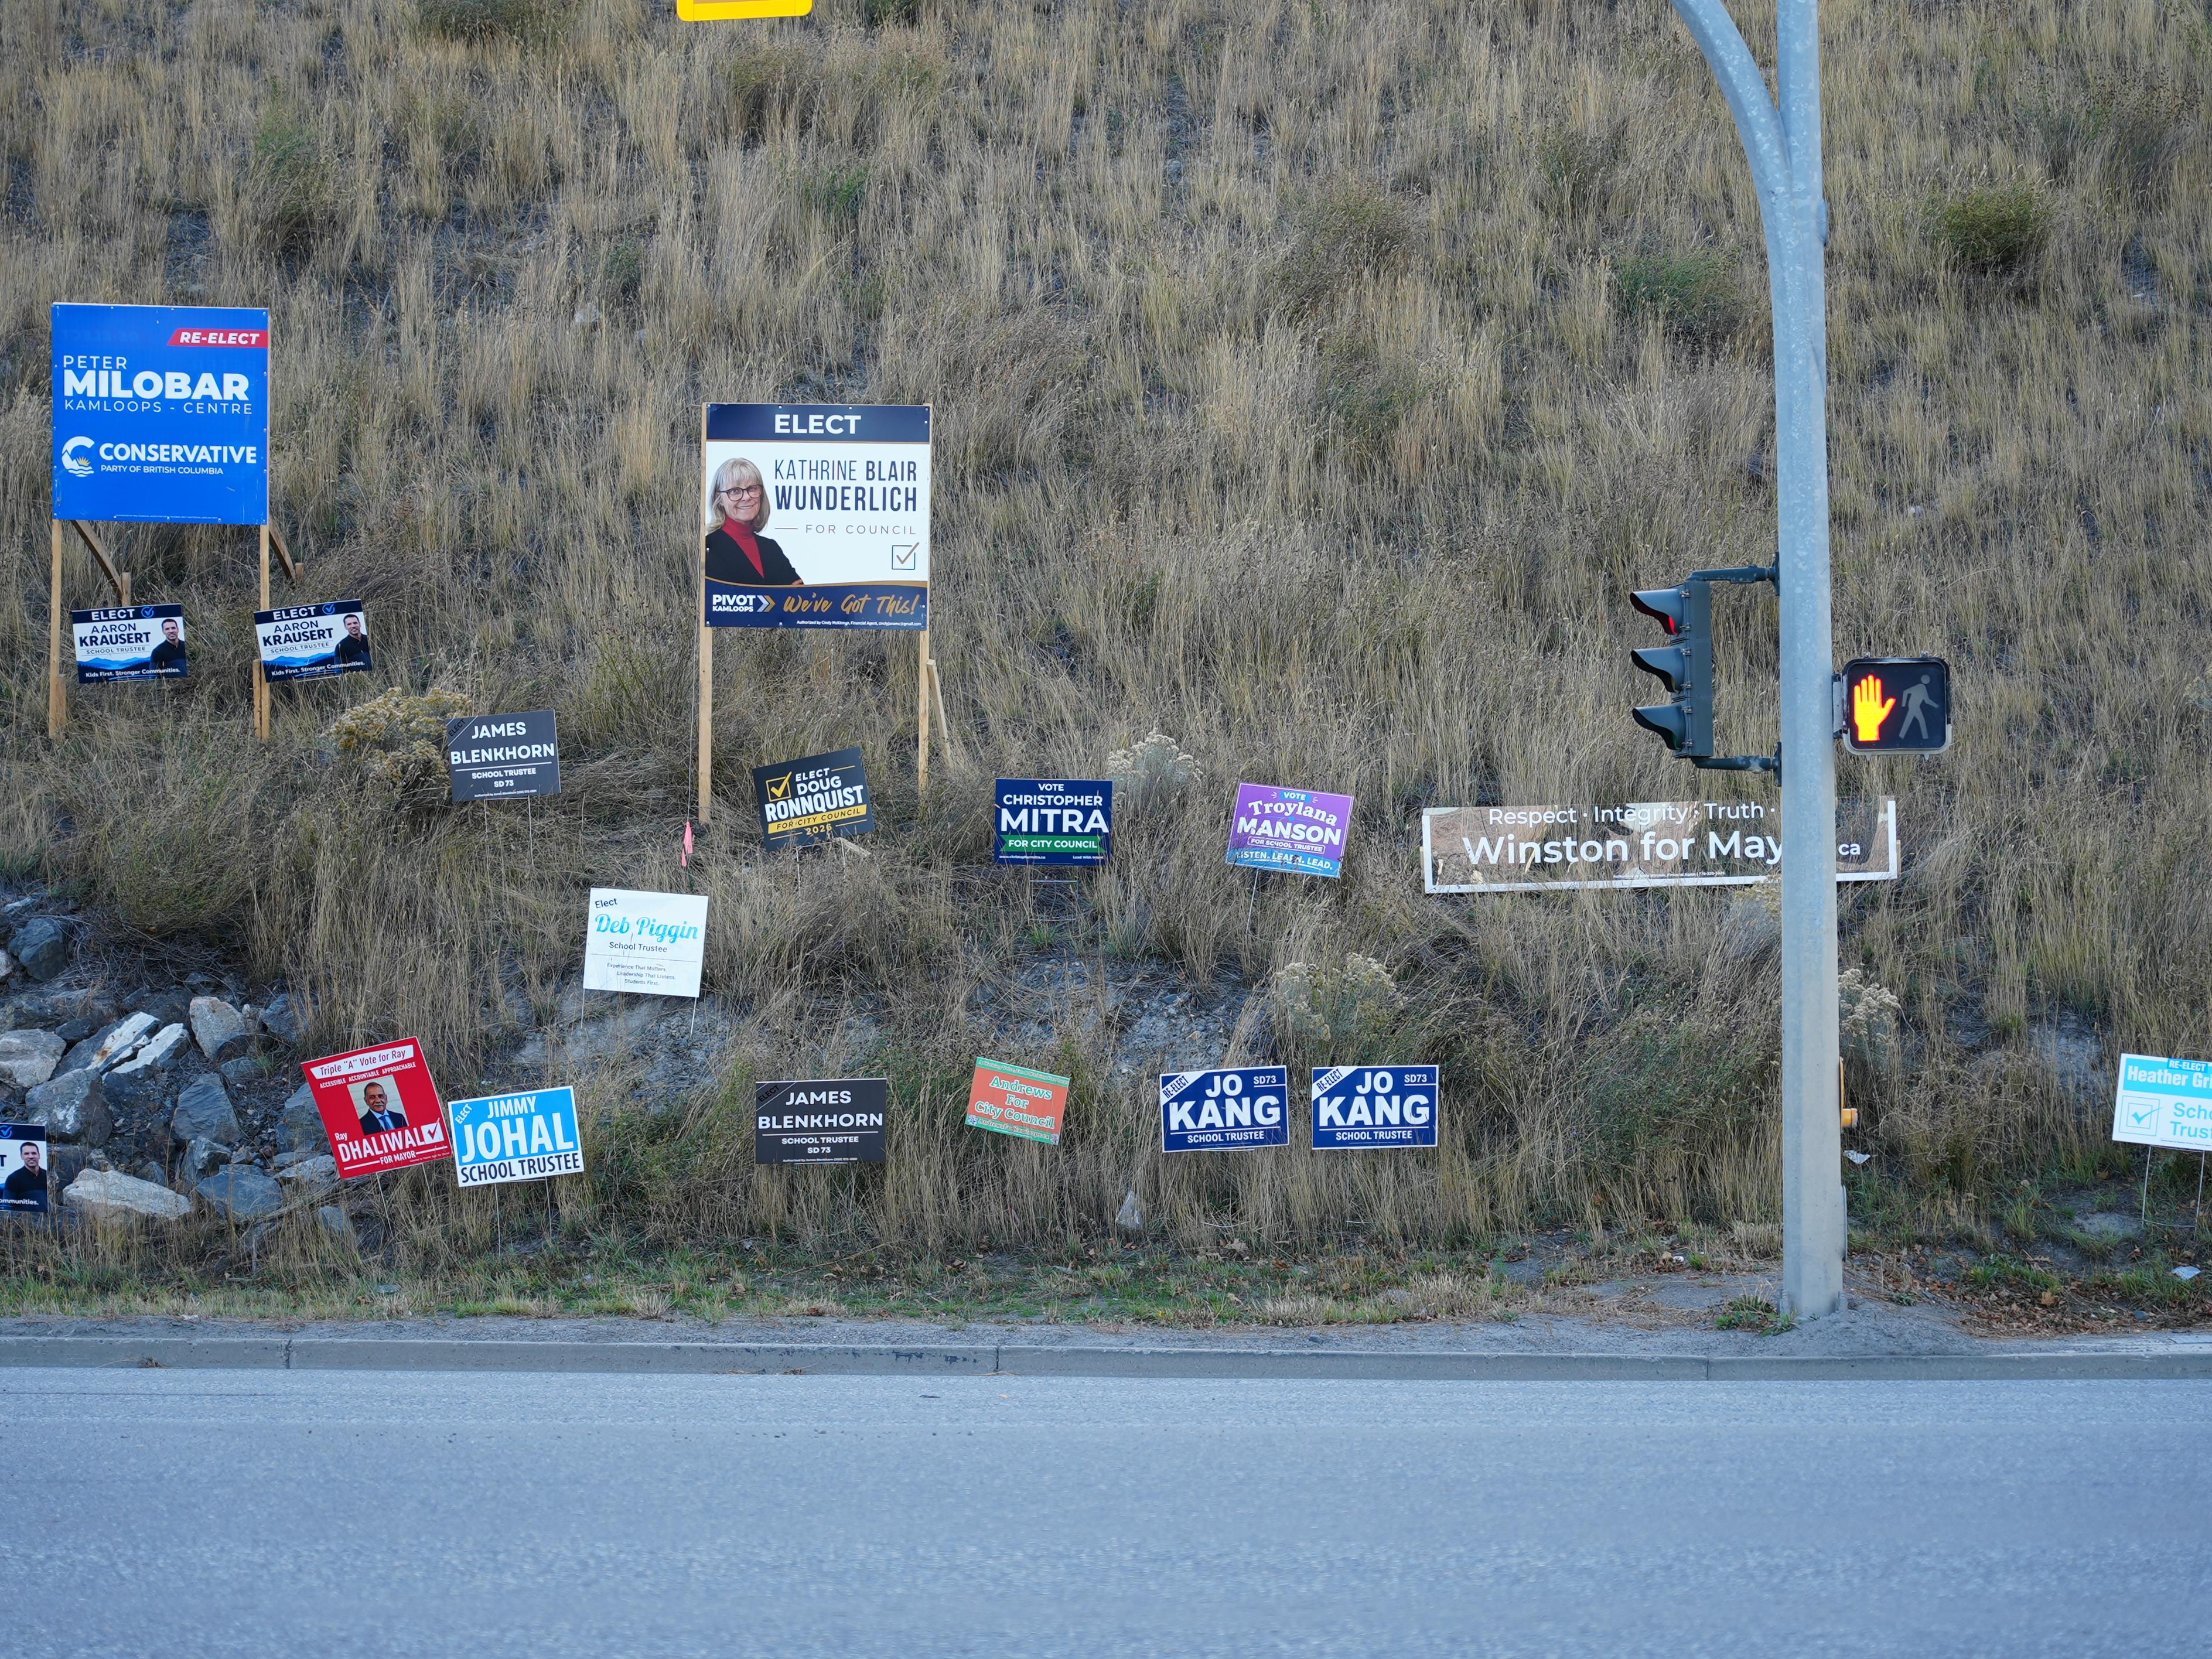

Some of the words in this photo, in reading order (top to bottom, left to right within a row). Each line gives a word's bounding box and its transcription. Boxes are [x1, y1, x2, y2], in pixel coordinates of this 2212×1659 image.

[180, 332, 260, 344] RE-ELECT
[63, 355, 127, 370] PETER
[64, 370, 249, 401] MILOBAR
[65, 400, 162, 412] KAMLOOPS
[183, 402, 252, 415] CENTRE
[774, 414, 861, 434] ELECT
[100, 443, 257, 464] CONSERVATIVE
[774, 459, 857, 482] KATHRINE
[866, 460, 917, 482] BLAIR
[775, 485, 917, 511] WUNDERLICH
[806, 524, 836, 534] FOR
[846, 525, 916, 535] COUNCIL
[712, 594, 756, 606] PIVOT
[783, 592, 832, 613] We've
[841, 594, 872, 615] Got
[876, 594, 920, 617] This!
[91, 609, 135, 620] ELECT
[273, 606, 316, 620] ELECT
[91, 623, 136, 634] AARON
[274, 620, 318, 633] AARON
[79, 632, 151, 647] KRAUSERT
[262, 628, 333, 646] KRAUSERT
[326, 661, 366, 670] Communities.
[448, 719, 466, 737] ELECT
[472, 722, 527, 739] JAMES
[450, 743, 555, 764] BLENKHORN
[472, 770, 504, 779] SCHOOL
[504, 768, 537, 777] TRUSTEE
[796, 767, 830, 781] ELECT
[797, 776, 842, 795] DOUG
[764, 785, 863, 822] RONNQUIST
[1003, 794, 1102, 806] CHRISTOPHER
[1283, 792, 1306, 800] VOTE
[777, 821, 793, 830] FOR
[797, 817, 817, 825] CITY
[821, 808, 861, 821] COUNCIL
[1001, 808, 1109, 832] MITRA
[1248, 800, 1337, 826] Troylana
[1489, 808, 1577, 828] Respect
[1595, 804, 1688, 825] Integrity
[1704, 801, 1763, 820] Truth
[806, 824, 832, 835] 2026
[1237, 817, 1341, 845] MANSON
[1008, 839, 1028, 848] FOR
[1030, 839, 1052, 848] CITY
[1054, 840, 1097, 848] COUNCIL
[1293, 843, 1324, 852] TRUSTEE
[1462, 834, 1629, 865] Winston
[1641, 831, 1695, 861] for
[1307, 858, 1333, 870] LEAD.
[595, 898, 617, 909] Elect
[595, 913, 630, 934] Deb
[636, 916, 698, 944] Piggin
[609, 941, 636, 950] School
[638, 944, 667, 953] Trustee
[320, 1064, 342, 1076] Triple
[360, 1054, 377, 1066] Vote
[379, 1053, 389, 1062] for
[391, 1050, 405, 1060] Ray
[2169, 1059, 2206, 1072] RE-ELECT
[320, 1077, 346, 1088] ACCESSIBLE
[349, 1070, 380, 1082] ACCOUNTABLE
[382, 1061, 417, 1074] APPROACHABLE
[1254, 1075, 1276, 1084] SD73
[1316, 1069, 1343, 1092] RE-ELECT
[1356, 1071, 1393, 1094] JO
[1404, 1074, 1427, 1083] SD73
[2128, 1065, 2189, 1087] Heather
[758, 1084, 780, 1102] ELECT
[989, 1076, 1053, 1100] Andrews
[1162, 1075, 1189, 1098] RE-ELECT
[1206, 1074, 1242, 1097] JO
[786, 1090, 852, 1105] JAMES
[1005, 1094, 1029, 1110] For
[455, 1104, 472, 1125] ELECT
[487, 1096, 537, 1119] JIMMY
[975, 1101, 1003, 1119] City
[1005, 1109, 1055, 1129] Council
[1169, 1095, 1281, 1131] KANG
[1319, 1094, 1429, 1127] KANG
[758, 1113, 883, 1129] BLENKHORN
[334, 1132, 348, 1142] Ray
[337, 1127, 427, 1163] DHALIWAL
[462, 1112, 574, 1163] JOHAL
[1187, 1134, 1224, 1143] SCHOOL
[1225, 1131, 1264, 1141] TRUSTEE
[1336, 1131, 1372, 1141] SCHOOL
[1373, 1131, 1412, 1139] TRUSTEE
[380, 1155, 394, 1165] FOR
[394, 1150, 417, 1162] MAYOR
[461, 1161, 516, 1183] SCHOOL
[518, 1152, 580, 1176] TRUSTEE
